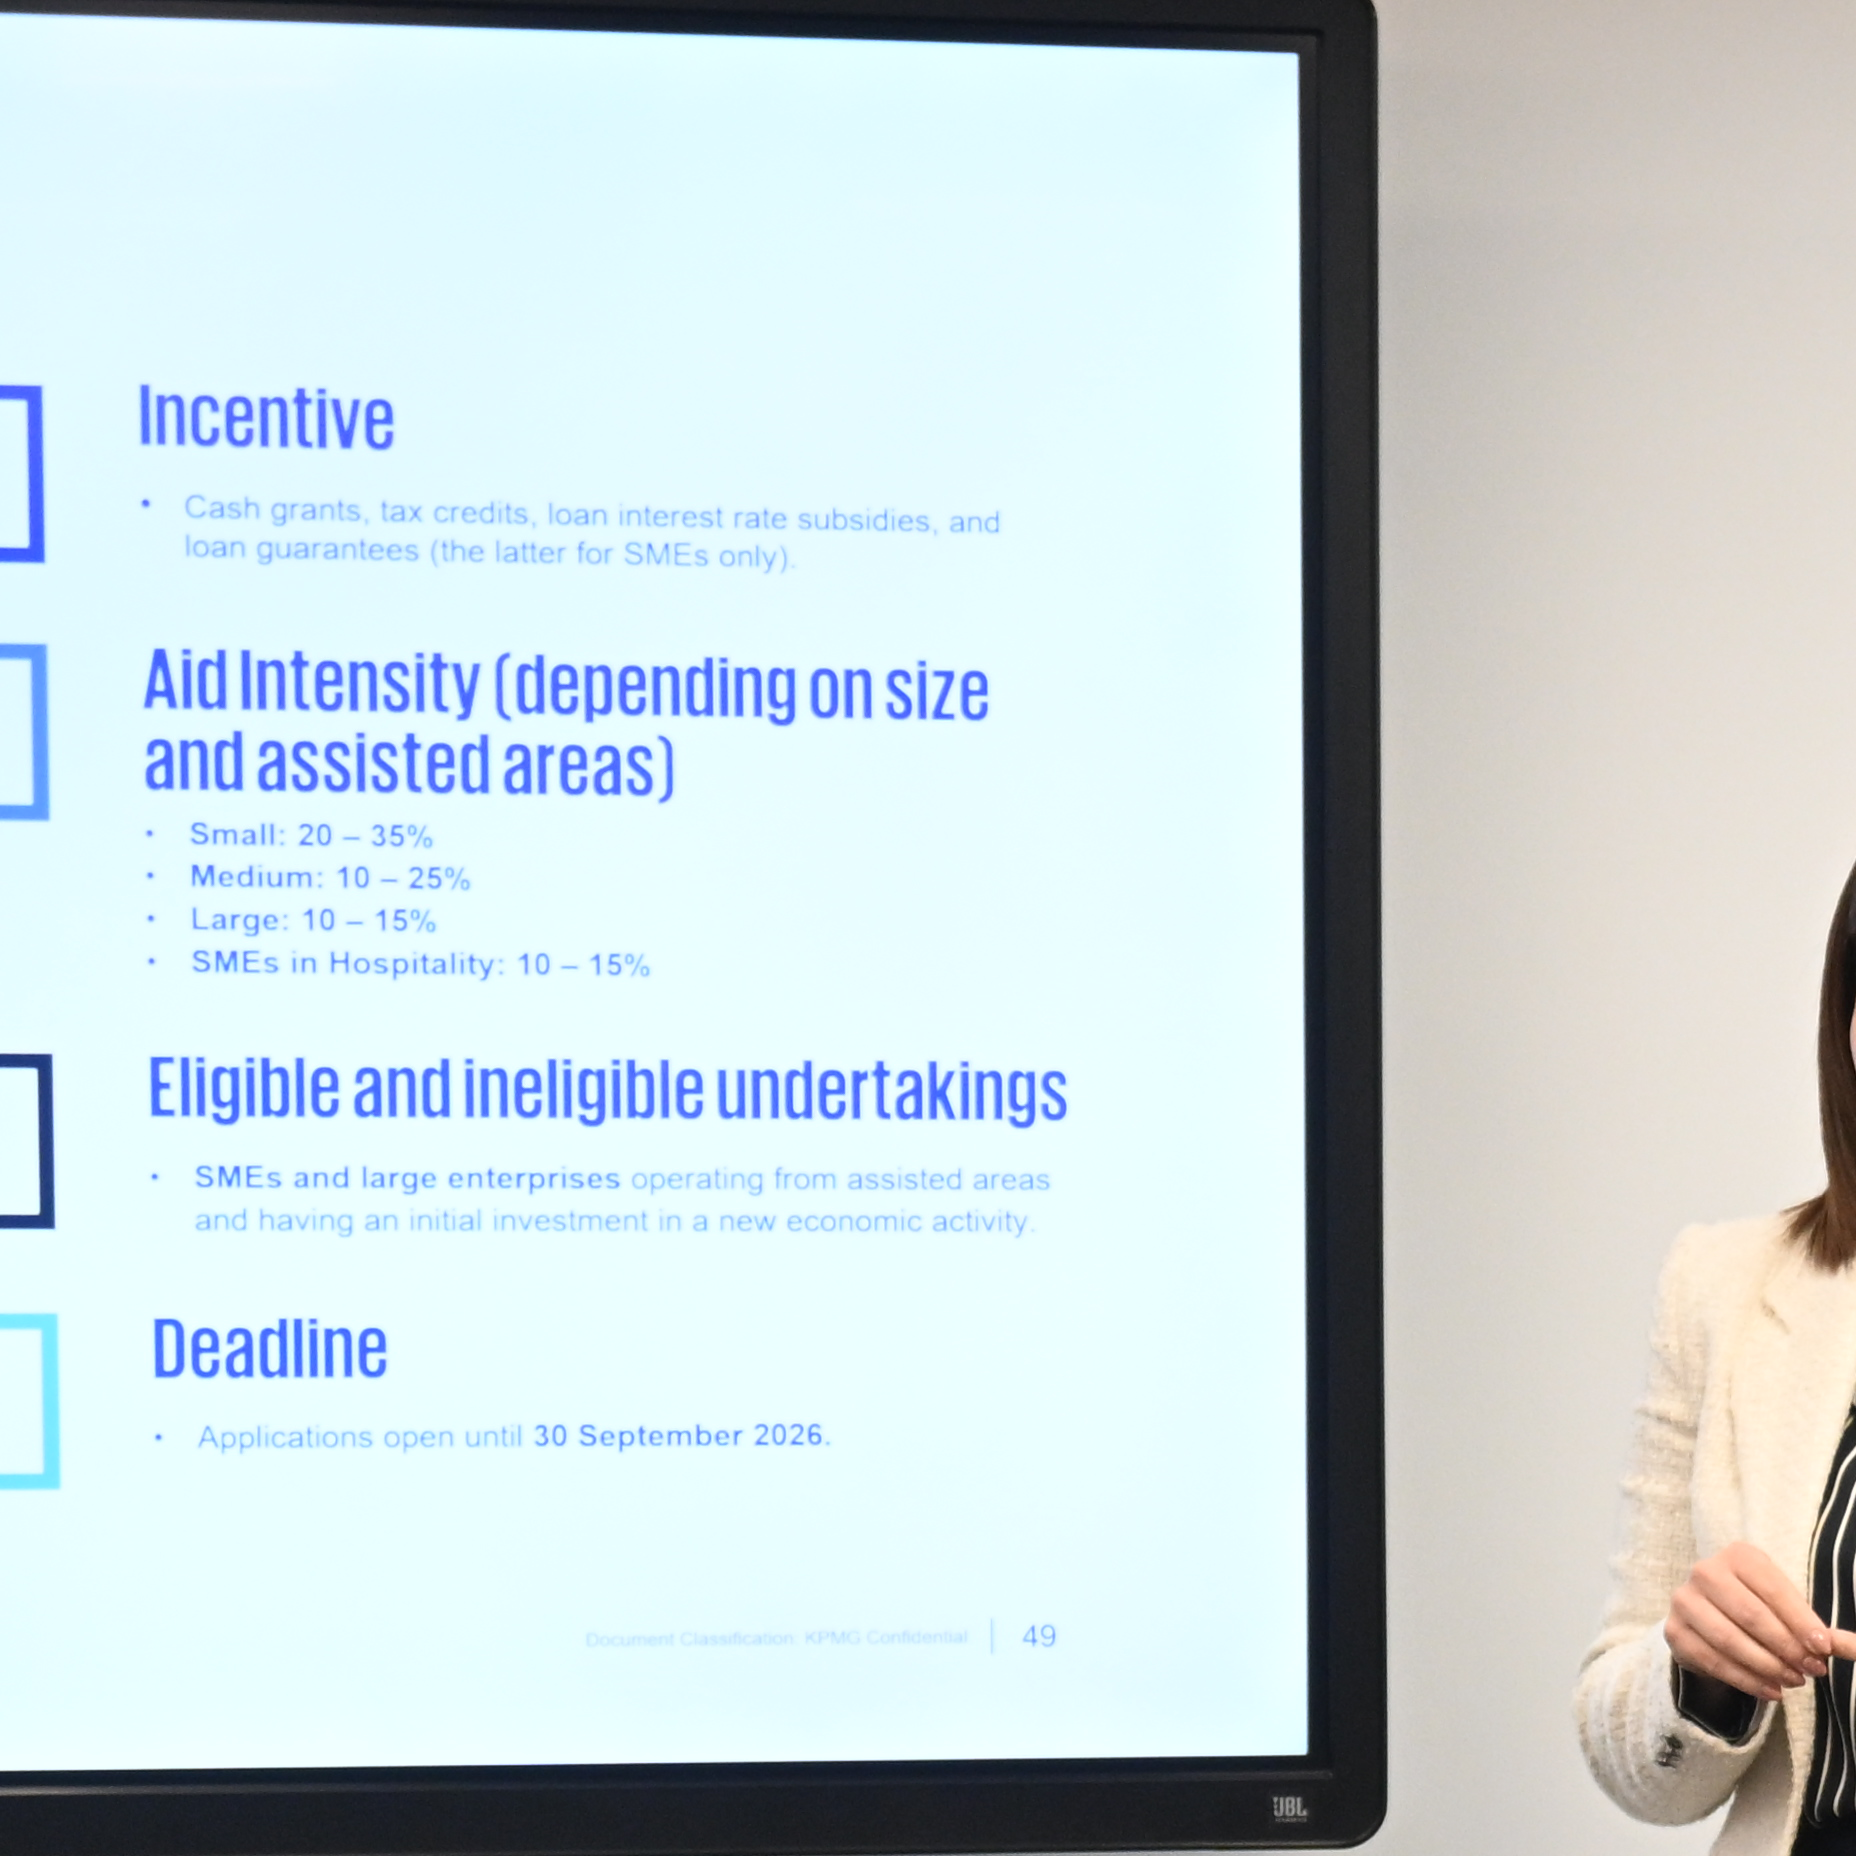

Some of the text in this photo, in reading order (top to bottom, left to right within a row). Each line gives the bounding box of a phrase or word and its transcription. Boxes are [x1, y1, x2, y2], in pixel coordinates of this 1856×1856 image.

[139, 383, 395, 451] Incentive
[184, 493, 1001, 536] Cash grants, tax credits, loan interest rate subsidies, and
[184, 533, 247, 559] loan
[255, 538, 421, 566] guarantees
[429, 538, 486, 568] (the
[495, 539, 567, 565] latter
[576, 540, 614, 566] for
[623, 540, 710, 568] SMEs
[143, 647, 989, 727] Aid Intensity (depending on size
[144, 730, 674, 804] and assisted areas)
[189, 821, 285, 847] Small:
[298, 822, 333, 848] 20
[371, 823, 434, 849] 35%
[190, 863, 323, 889] Medium:
[337, 865, 371, 890] 10
[408, 865, 472, 892] 25%
[191, 906, 288, 938] Large:
[303, 907, 336, 932] 10
[375, 908, 437, 934] 15%
[191, 949, 280, 975] SMEs
[291, 949, 318, 975] in
[329, 950, 504, 982] Hospitality:
[518, 951, 551, 977] 10
[590, 952, 651, 978] 15%
[149, 1056, 1068, 1130] Eligible and ineligible undertakings
[194, 1164, 1051, 1197] SMEs and large enterprises operating from assisted areas
[194, 1207, 249, 1233] and
[258, 1207, 355, 1239] having
[363, 1213, 400, 1233] an
[409, 1208, 483, 1233] initial
[491, 1208, 649, 1234] investment
[657, 1208, 683, 1233] in
[691, 1213, 710, 1233] a
[719, 1213, 778, 1233] new
[786, 1214, 923, 1233] economic
[153, 1317, 387, 1380] Deadline
[197, 1422, 831, 1454] Applications open until 30 September 2026.
[1022, 1623, 1058, 1648] 49
[1272, 1796, 1309, 1817] JBL
